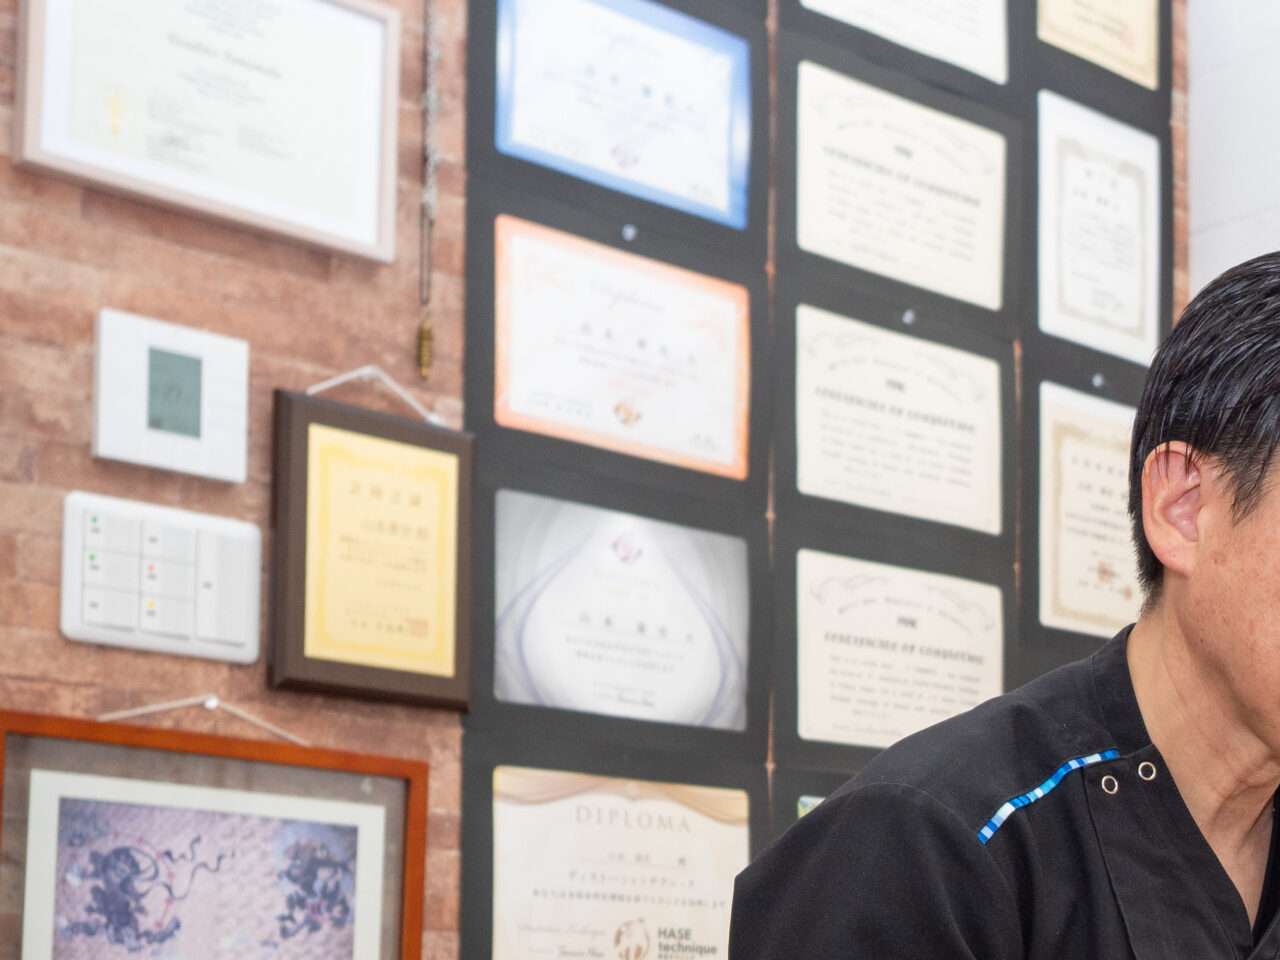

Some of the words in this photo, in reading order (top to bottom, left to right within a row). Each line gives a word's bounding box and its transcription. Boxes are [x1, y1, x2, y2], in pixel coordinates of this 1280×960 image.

[576, 806, 692, 833] DIPLOMA
[658, 928, 692, 940] HASE
[658, 941, 718, 957] technique
